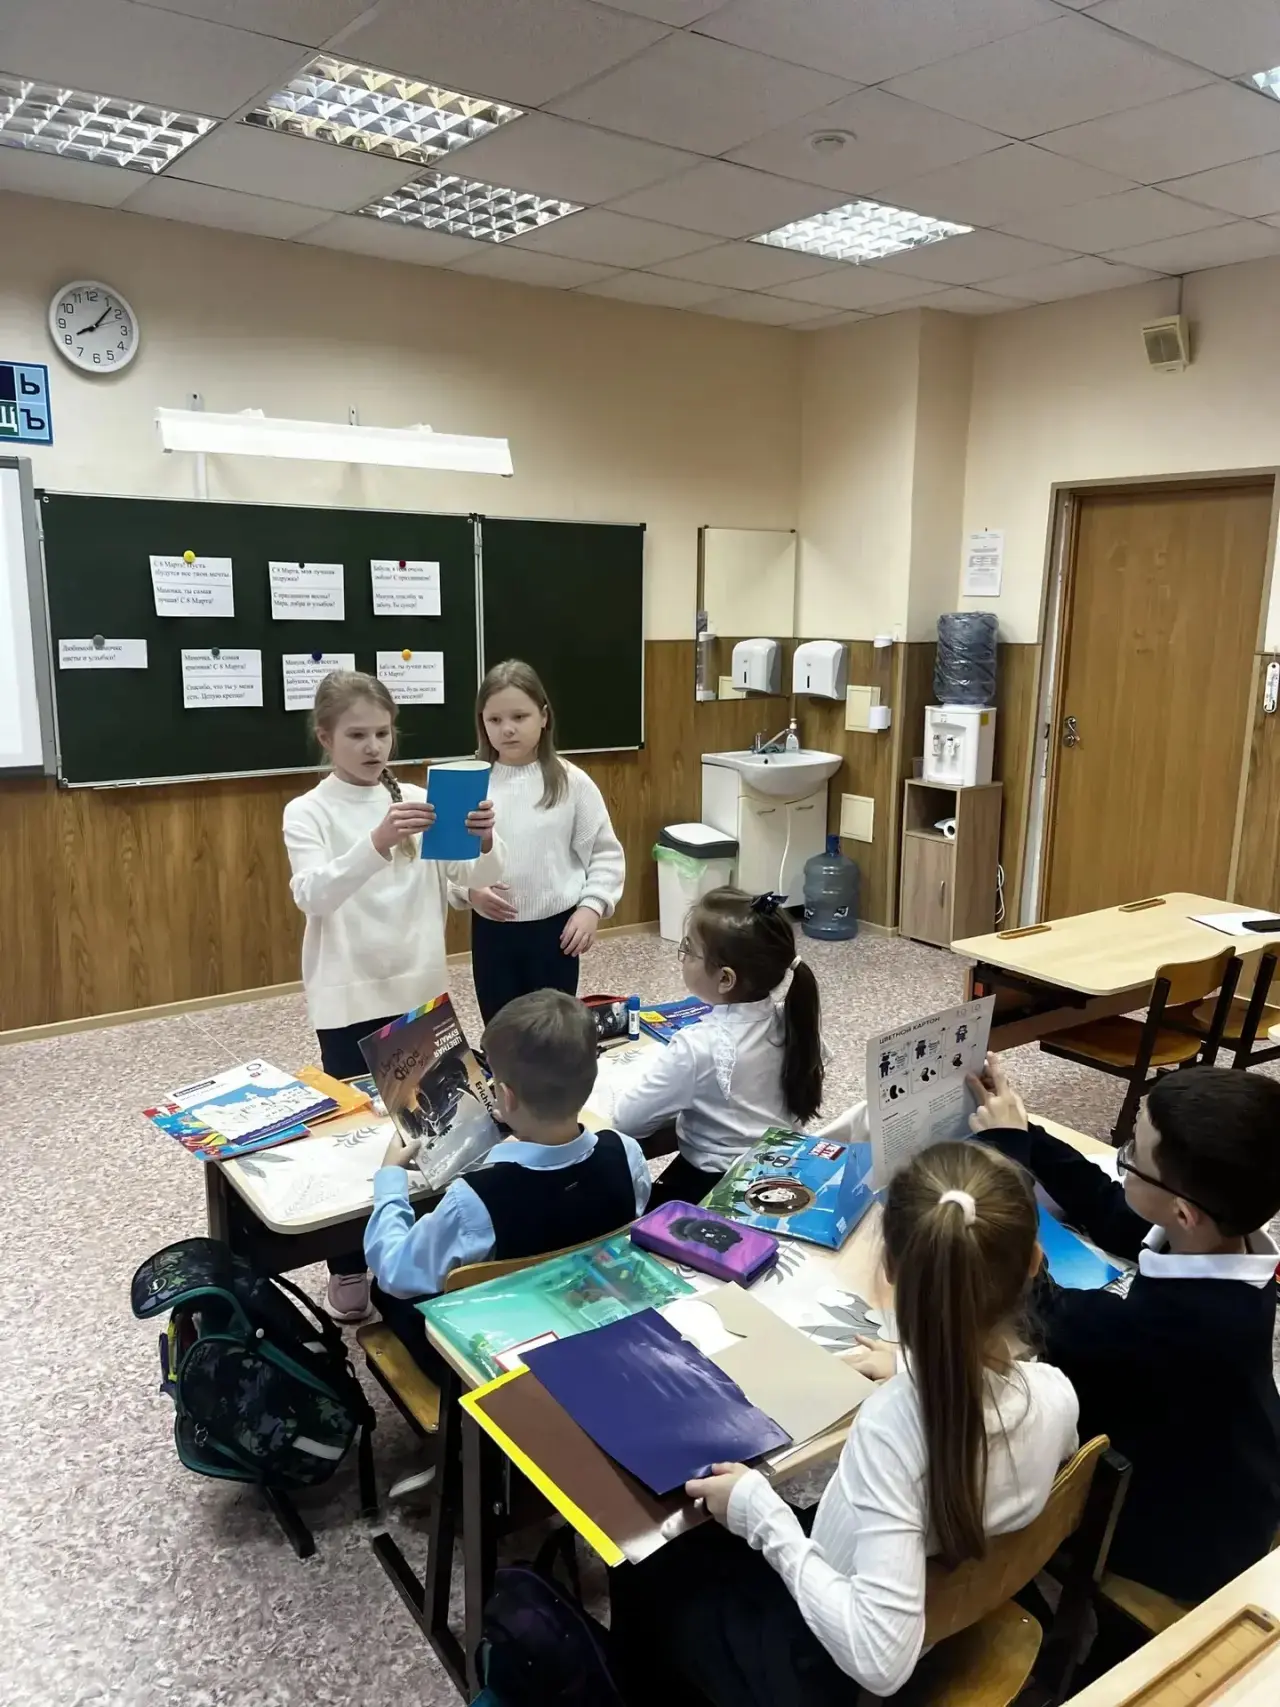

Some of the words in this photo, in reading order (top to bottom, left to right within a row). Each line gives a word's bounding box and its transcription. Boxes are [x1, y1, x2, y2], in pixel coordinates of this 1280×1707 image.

[72, 293, 82, 303] 11
[85, 291, 99, 301] 12
[104, 297, 110, 307] 1
[60, 303, 74, 314] 10
[114, 309, 122, 320] 2
[58, 318, 66, 329] 9
[120, 325, 128, 336] 3
[64, 334, 72, 345] 8
[117, 341, 125, 351] 4
[77, 347, 84, 358] 7
[106, 350, 114, 361] 5
[93, 353, 100, 364] 6
[879, 1026, 912, 1045] ЦВЕТНОЙ
[912, 1016, 941, 1031] КАРТОН
[434, 1028, 460, 1047] БУМАГА
[433, 1035, 463, 1058] ЦВЕТНАЯ
